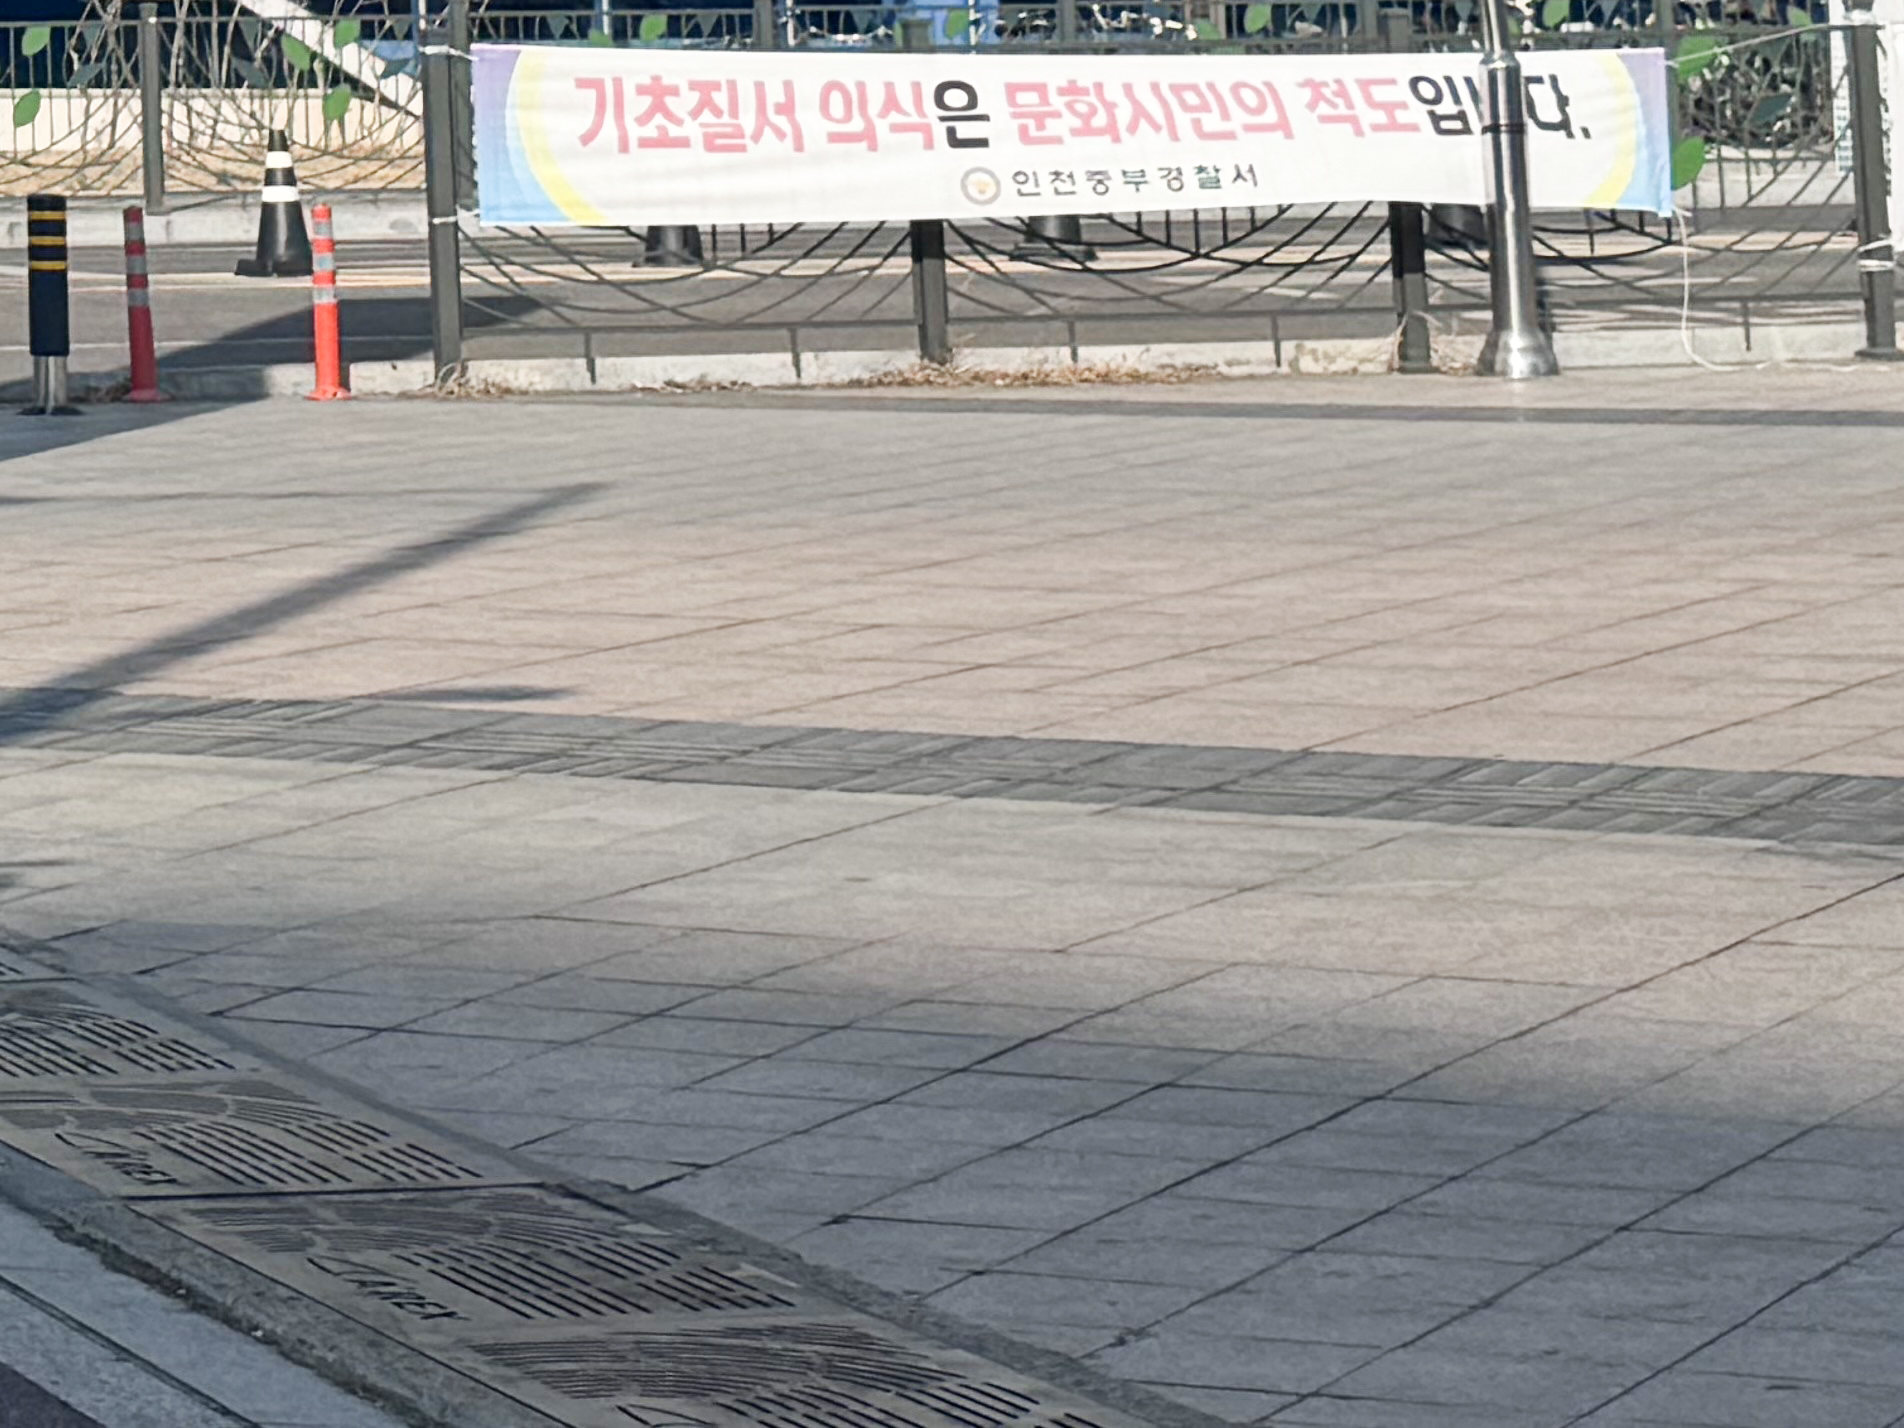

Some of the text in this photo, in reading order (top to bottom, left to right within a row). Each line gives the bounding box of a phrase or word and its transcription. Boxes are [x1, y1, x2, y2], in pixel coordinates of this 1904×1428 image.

[575, 75, 804, 154] 기초질서
[819, 79, 991, 153] 의식은
[1004, 79, 1295, 145] 문화시민의
